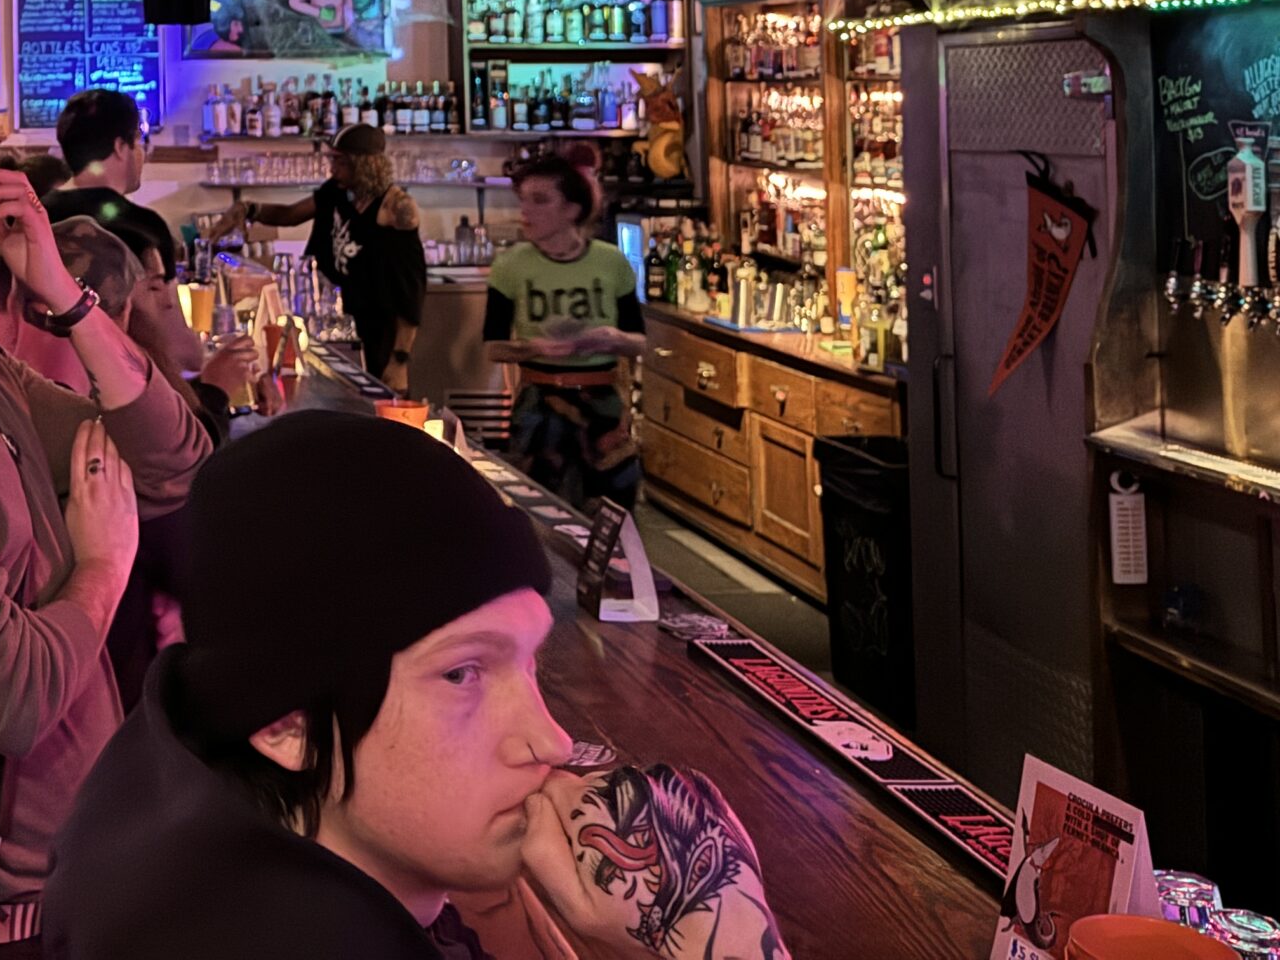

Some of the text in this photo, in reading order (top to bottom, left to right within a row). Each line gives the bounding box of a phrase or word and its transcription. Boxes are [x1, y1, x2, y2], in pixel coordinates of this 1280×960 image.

[22, 40, 81, 55] BOTTLES
[526, 278, 609, 321] brat
[1067, 792, 1134, 833] CROCULA PREFERS
[1073, 806, 1091, 822] COLD
